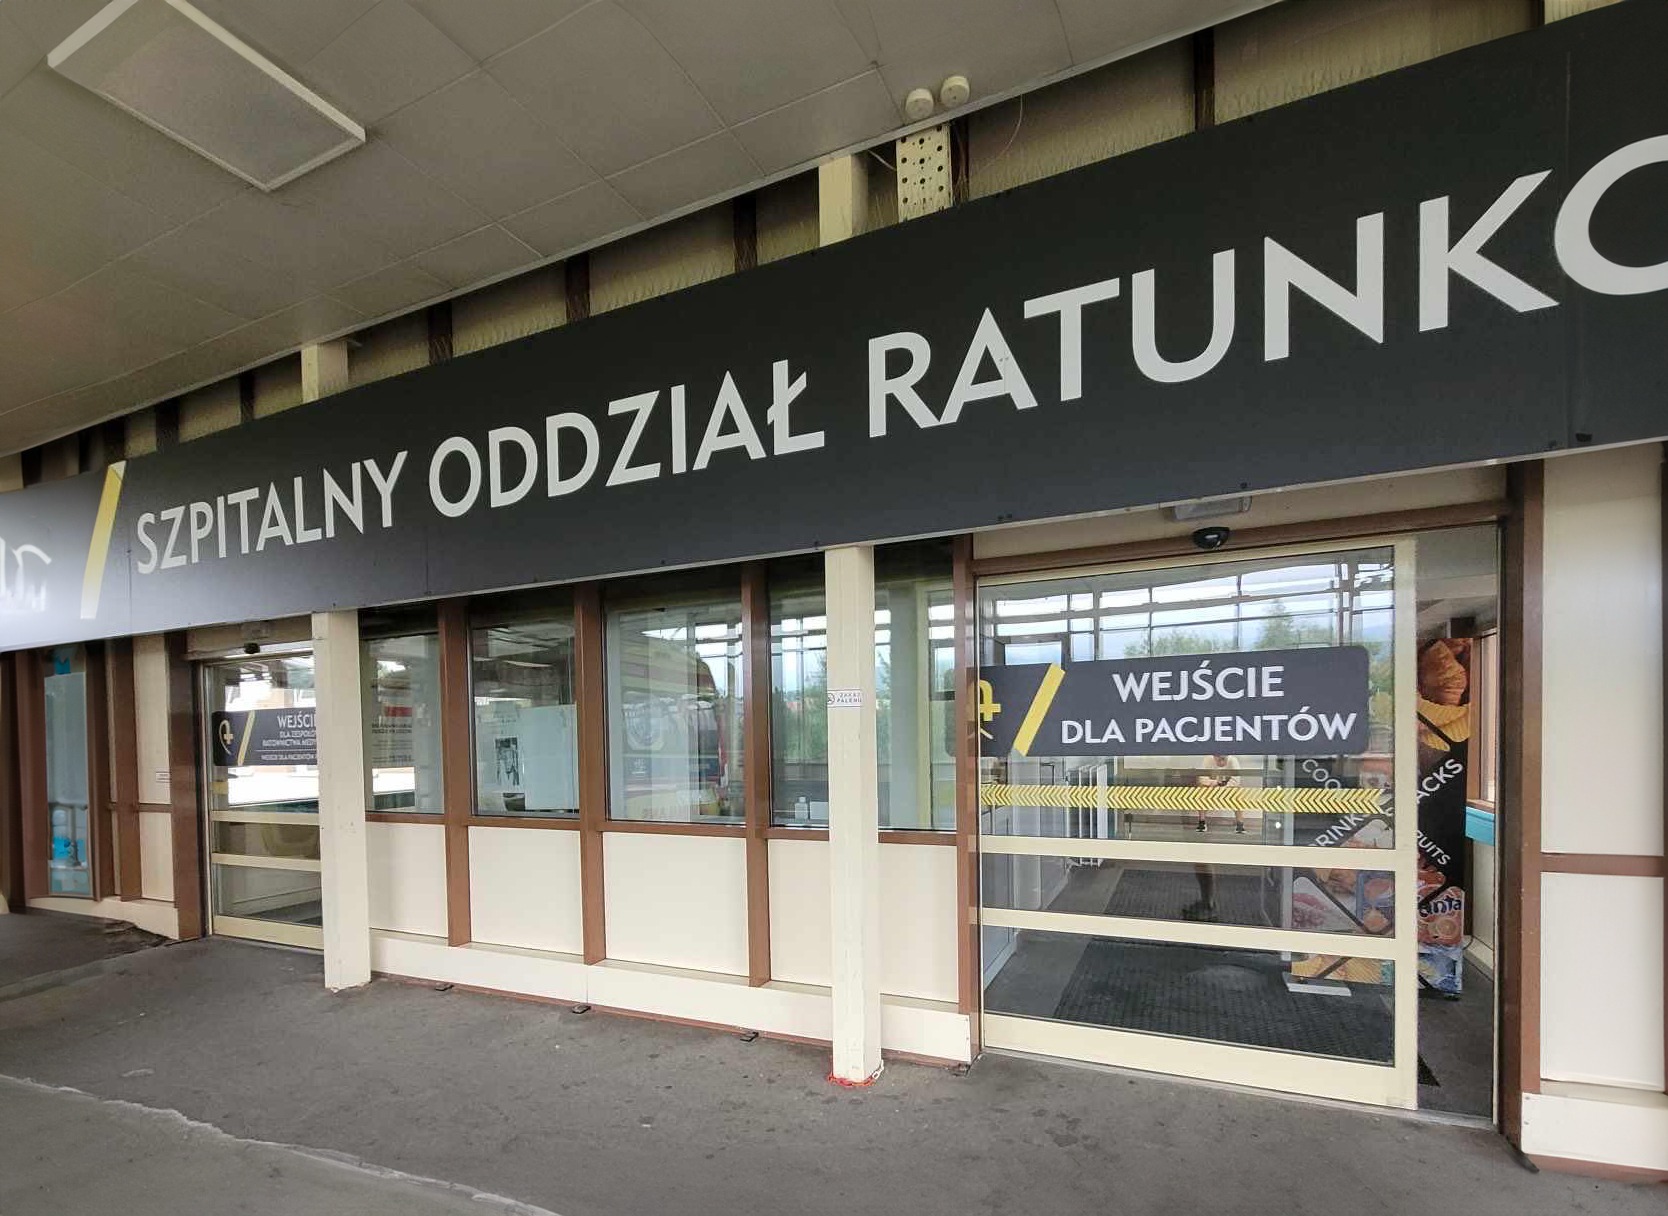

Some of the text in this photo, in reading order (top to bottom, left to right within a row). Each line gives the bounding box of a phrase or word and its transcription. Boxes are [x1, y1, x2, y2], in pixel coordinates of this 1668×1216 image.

[137, 134, 1668, 575] SZPITALNY ODDZIAŁ RATUNKO
[1112, 659, 1285, 702] WEJŚCIE
[1061, 706, 1356, 745] DLA PACJENTÓW
[1302, 759, 1340, 789] COO
[1416, 758, 1463, 804] ACKS
[1308, 813, 1366, 846] RINK
[1416, 831, 1452, 867] RUITS
[1418, 898, 1462, 920] anta
